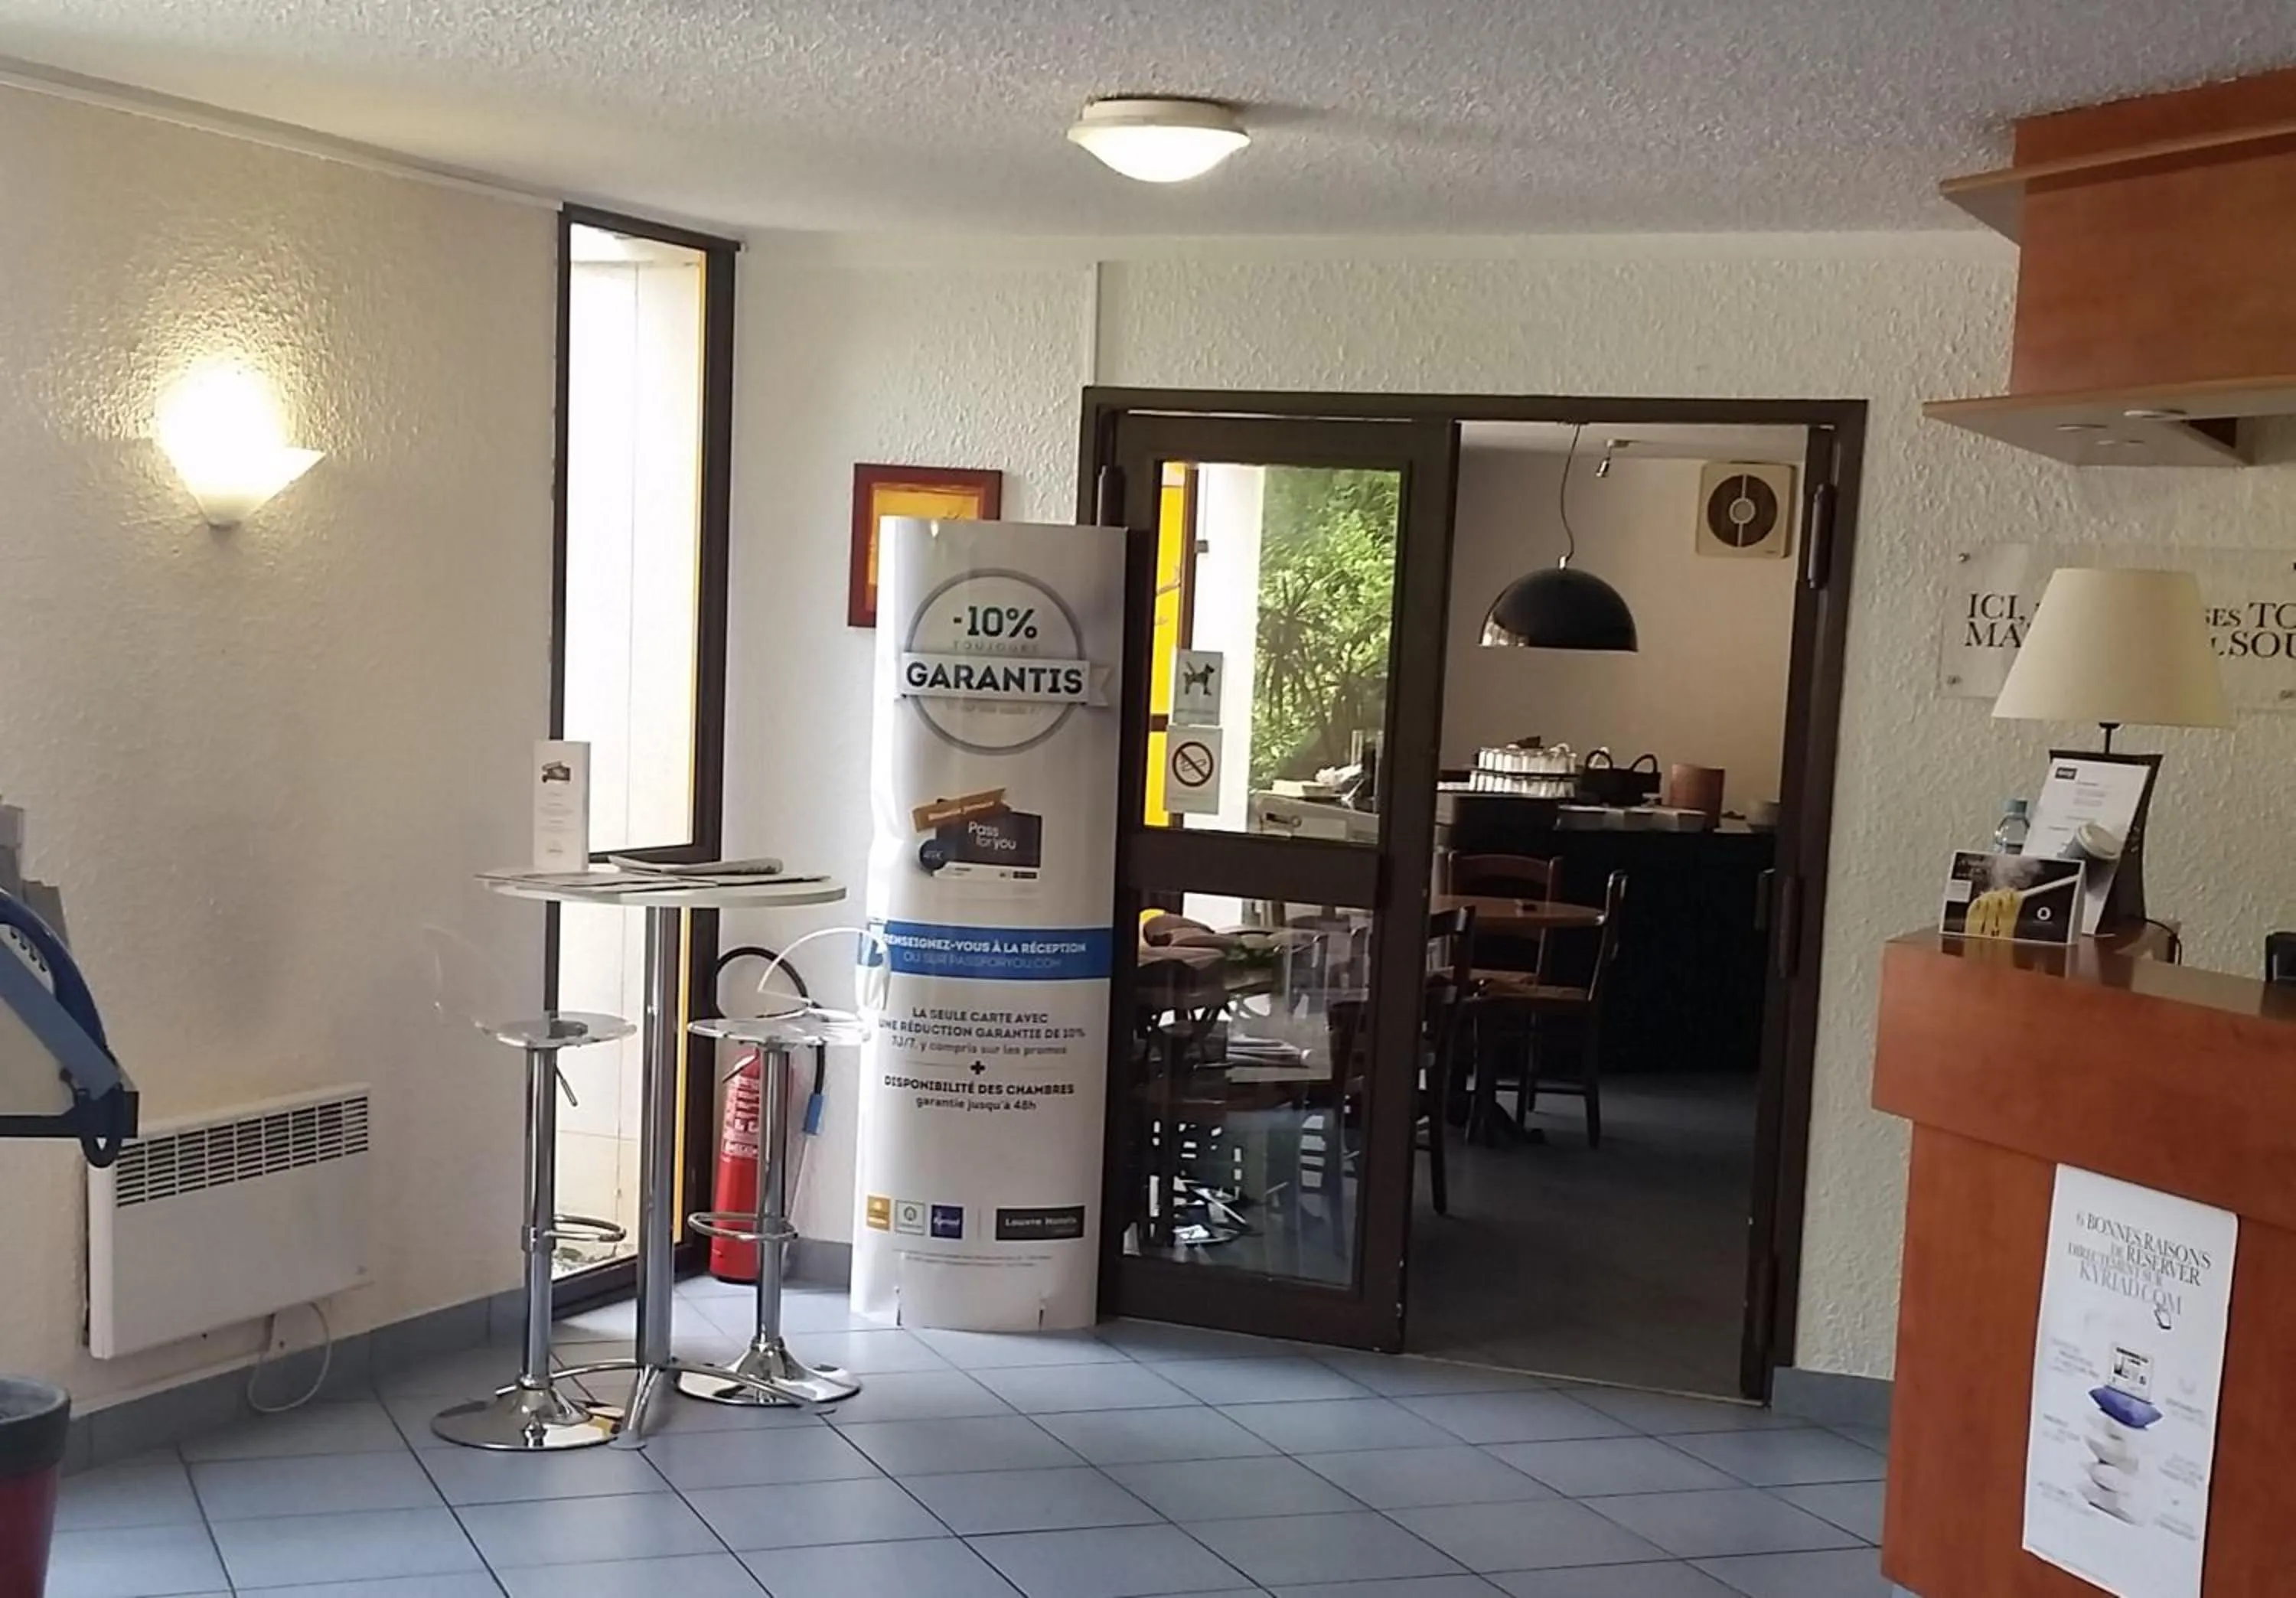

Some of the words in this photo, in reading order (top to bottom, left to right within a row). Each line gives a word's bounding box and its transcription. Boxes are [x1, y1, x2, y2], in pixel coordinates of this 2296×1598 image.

[1967, 593, 2026, 625] ICI,
[953, 605, 1038, 638] -10%
[906, 661, 1083, 695] GARANTIS
[968, 820, 1000, 837] Pass
[1003, 942, 1019, 954] LA
[1021, 940, 1086, 954] RÉCEPTION
[912, 1006, 927, 1019] LA
[930, 1009, 967, 1022] SEULE
[970, 1012, 1012, 1024] CARTE
[1015, 1013, 1049, 1024] AVEC
[900, 1019, 973, 1037] RÉDUCTION
[976, 1027, 1042, 1039] GARANTIE
[1044, 1028, 1060, 1039] DE
[884, 1075, 975, 1094] DISPONIBILITÉ
[978, 1083, 1003, 1095] DES
[1006, 1083, 1075, 1096] CHAMBRES
[916, 1097, 964, 1109] garantie
[1014, 1100, 1038, 1110] 48h
[2087, 1212, 2144, 1247] BONNES
[2144, 1232, 2212, 1270] RAISONS
